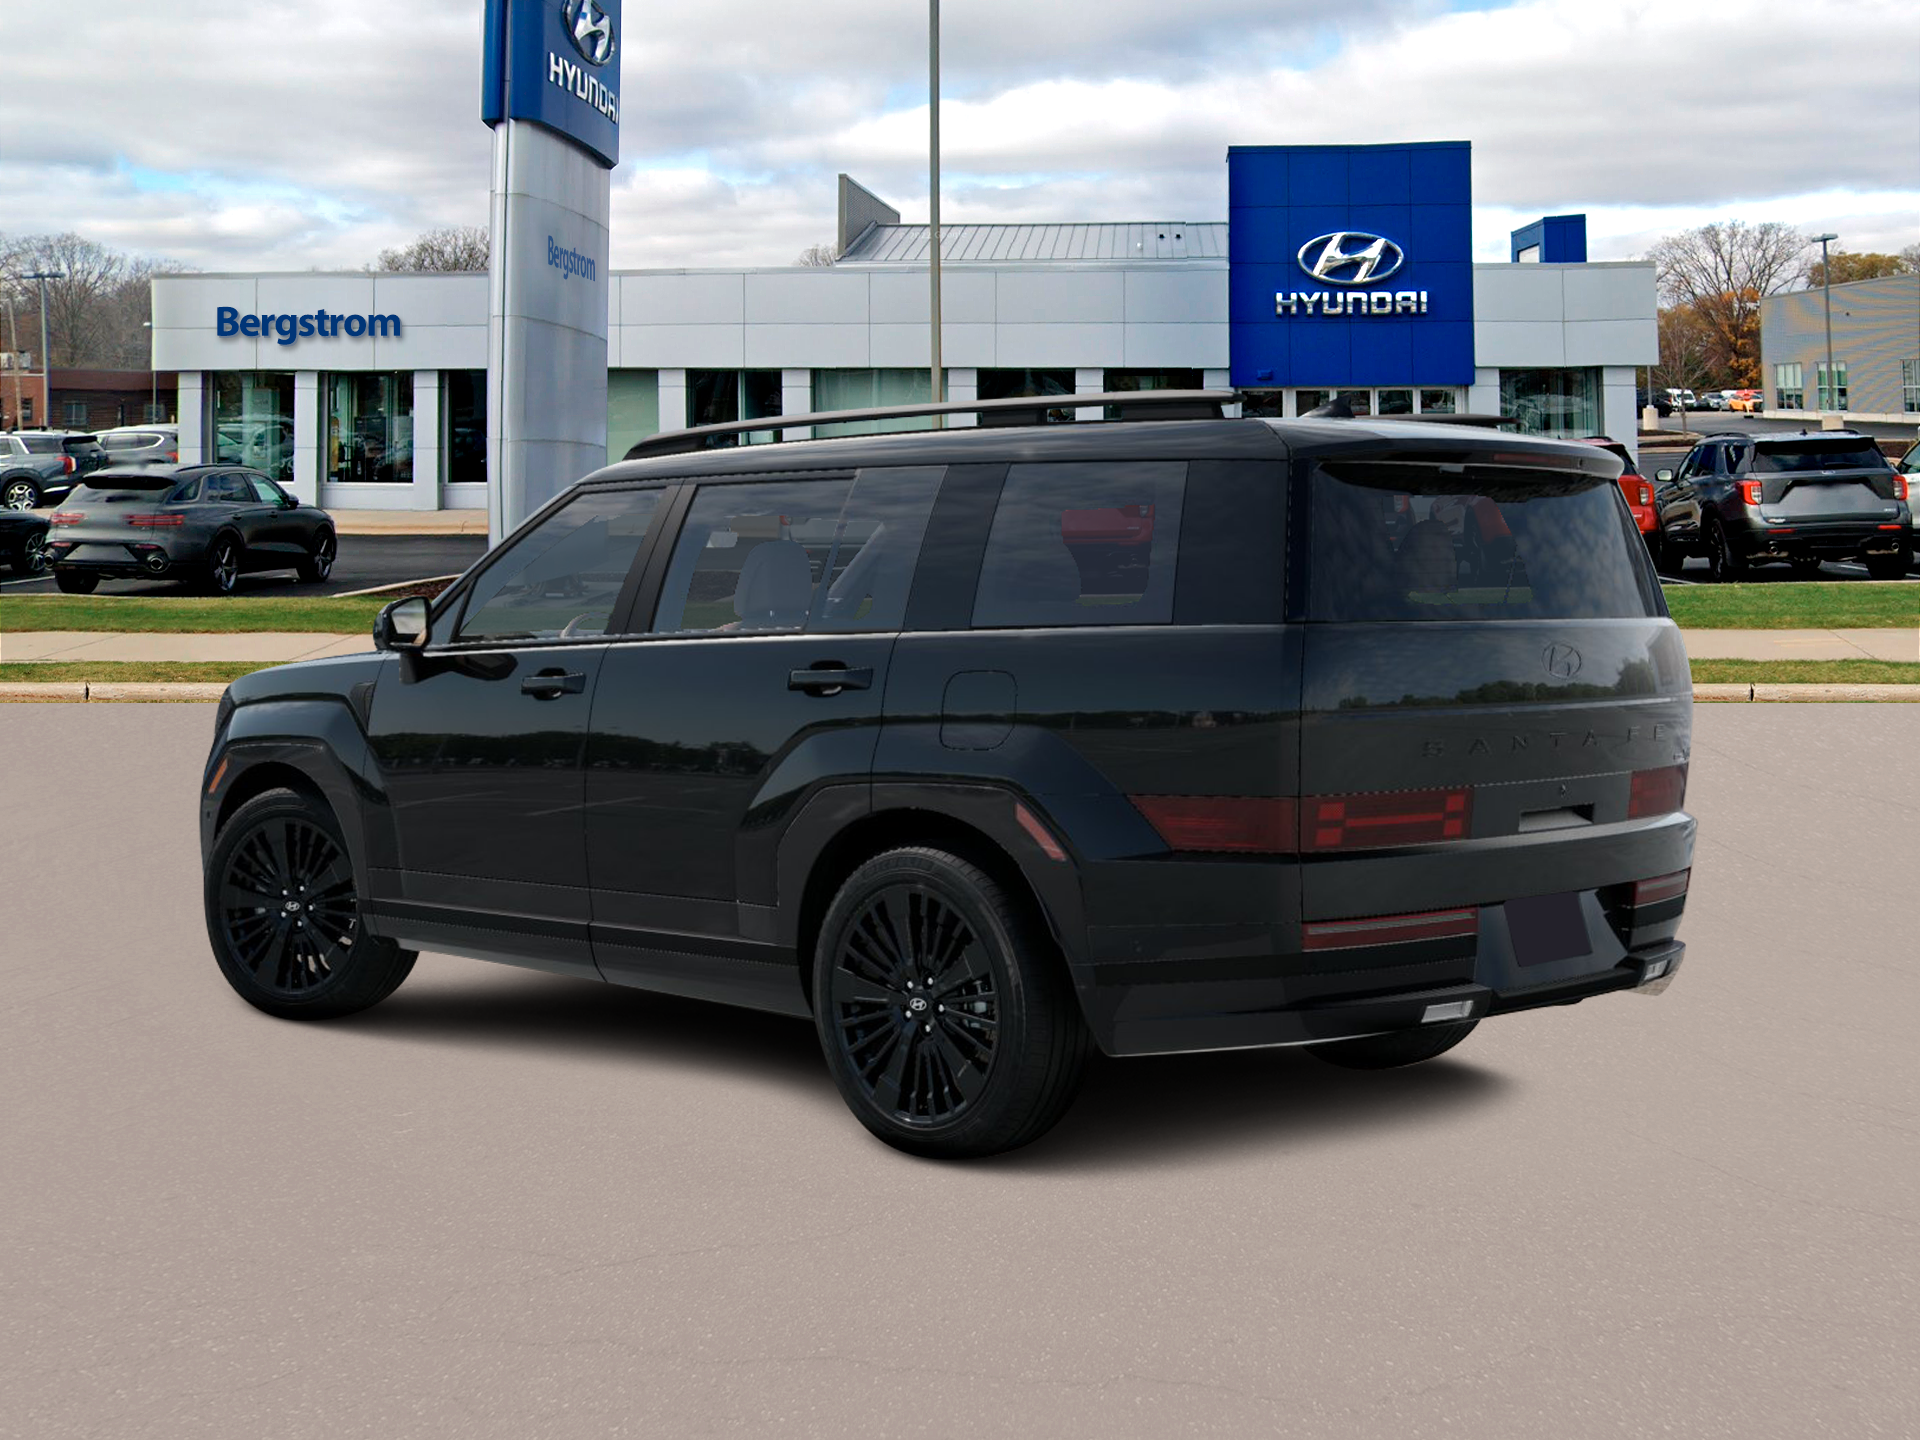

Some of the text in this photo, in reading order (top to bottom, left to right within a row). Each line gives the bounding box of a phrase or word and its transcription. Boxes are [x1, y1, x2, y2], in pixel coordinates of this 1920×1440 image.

[549, 52, 619, 124] HYUNDAI
[547, 235, 596, 282] Bergstrom
[1275, 290, 1428, 315] HYUNDAI
[217, 306, 401, 346] Bergstrom
[1422, 723, 1666, 758] SANTA FE
